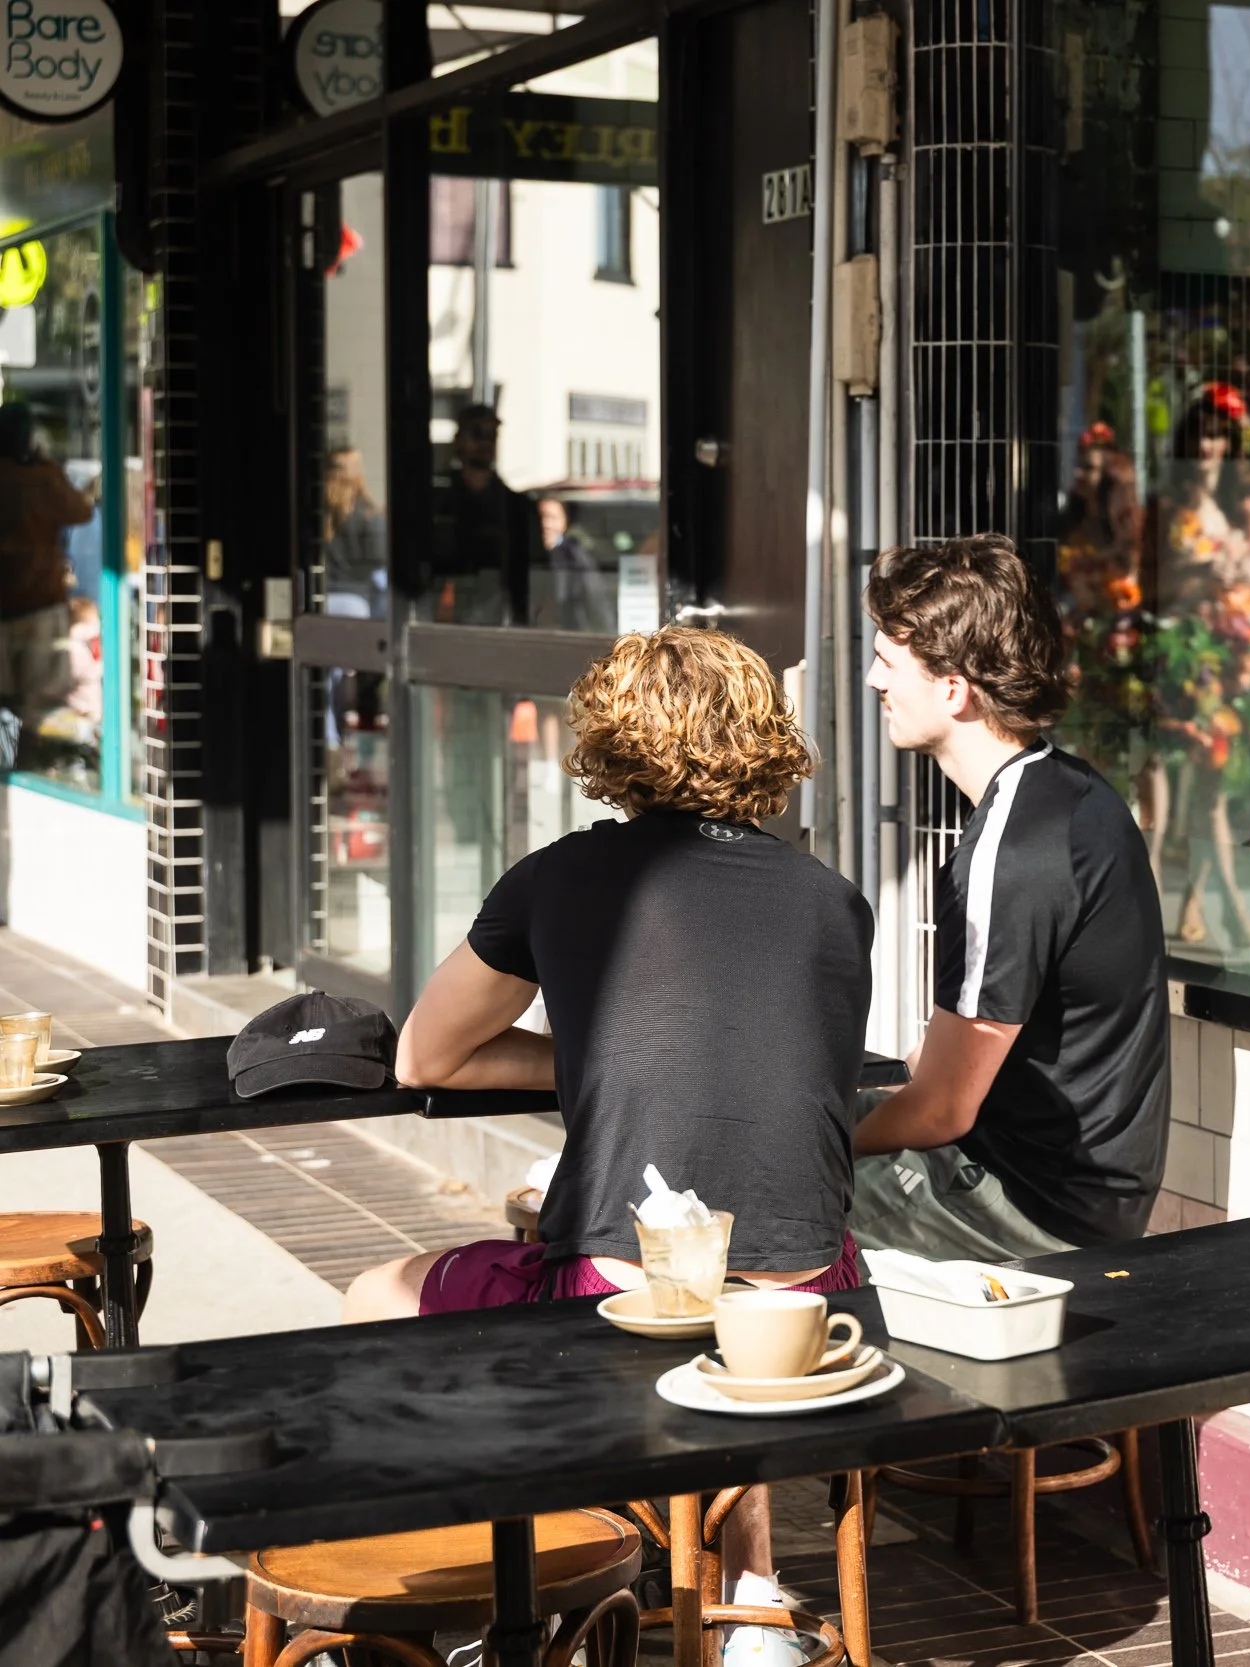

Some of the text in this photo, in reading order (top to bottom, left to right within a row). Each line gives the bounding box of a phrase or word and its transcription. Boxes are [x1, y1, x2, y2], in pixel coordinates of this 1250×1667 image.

[7, 0, 105, 43] Bare
[6, 41, 103, 91] Body
[765, 168, 812, 219] 281A
